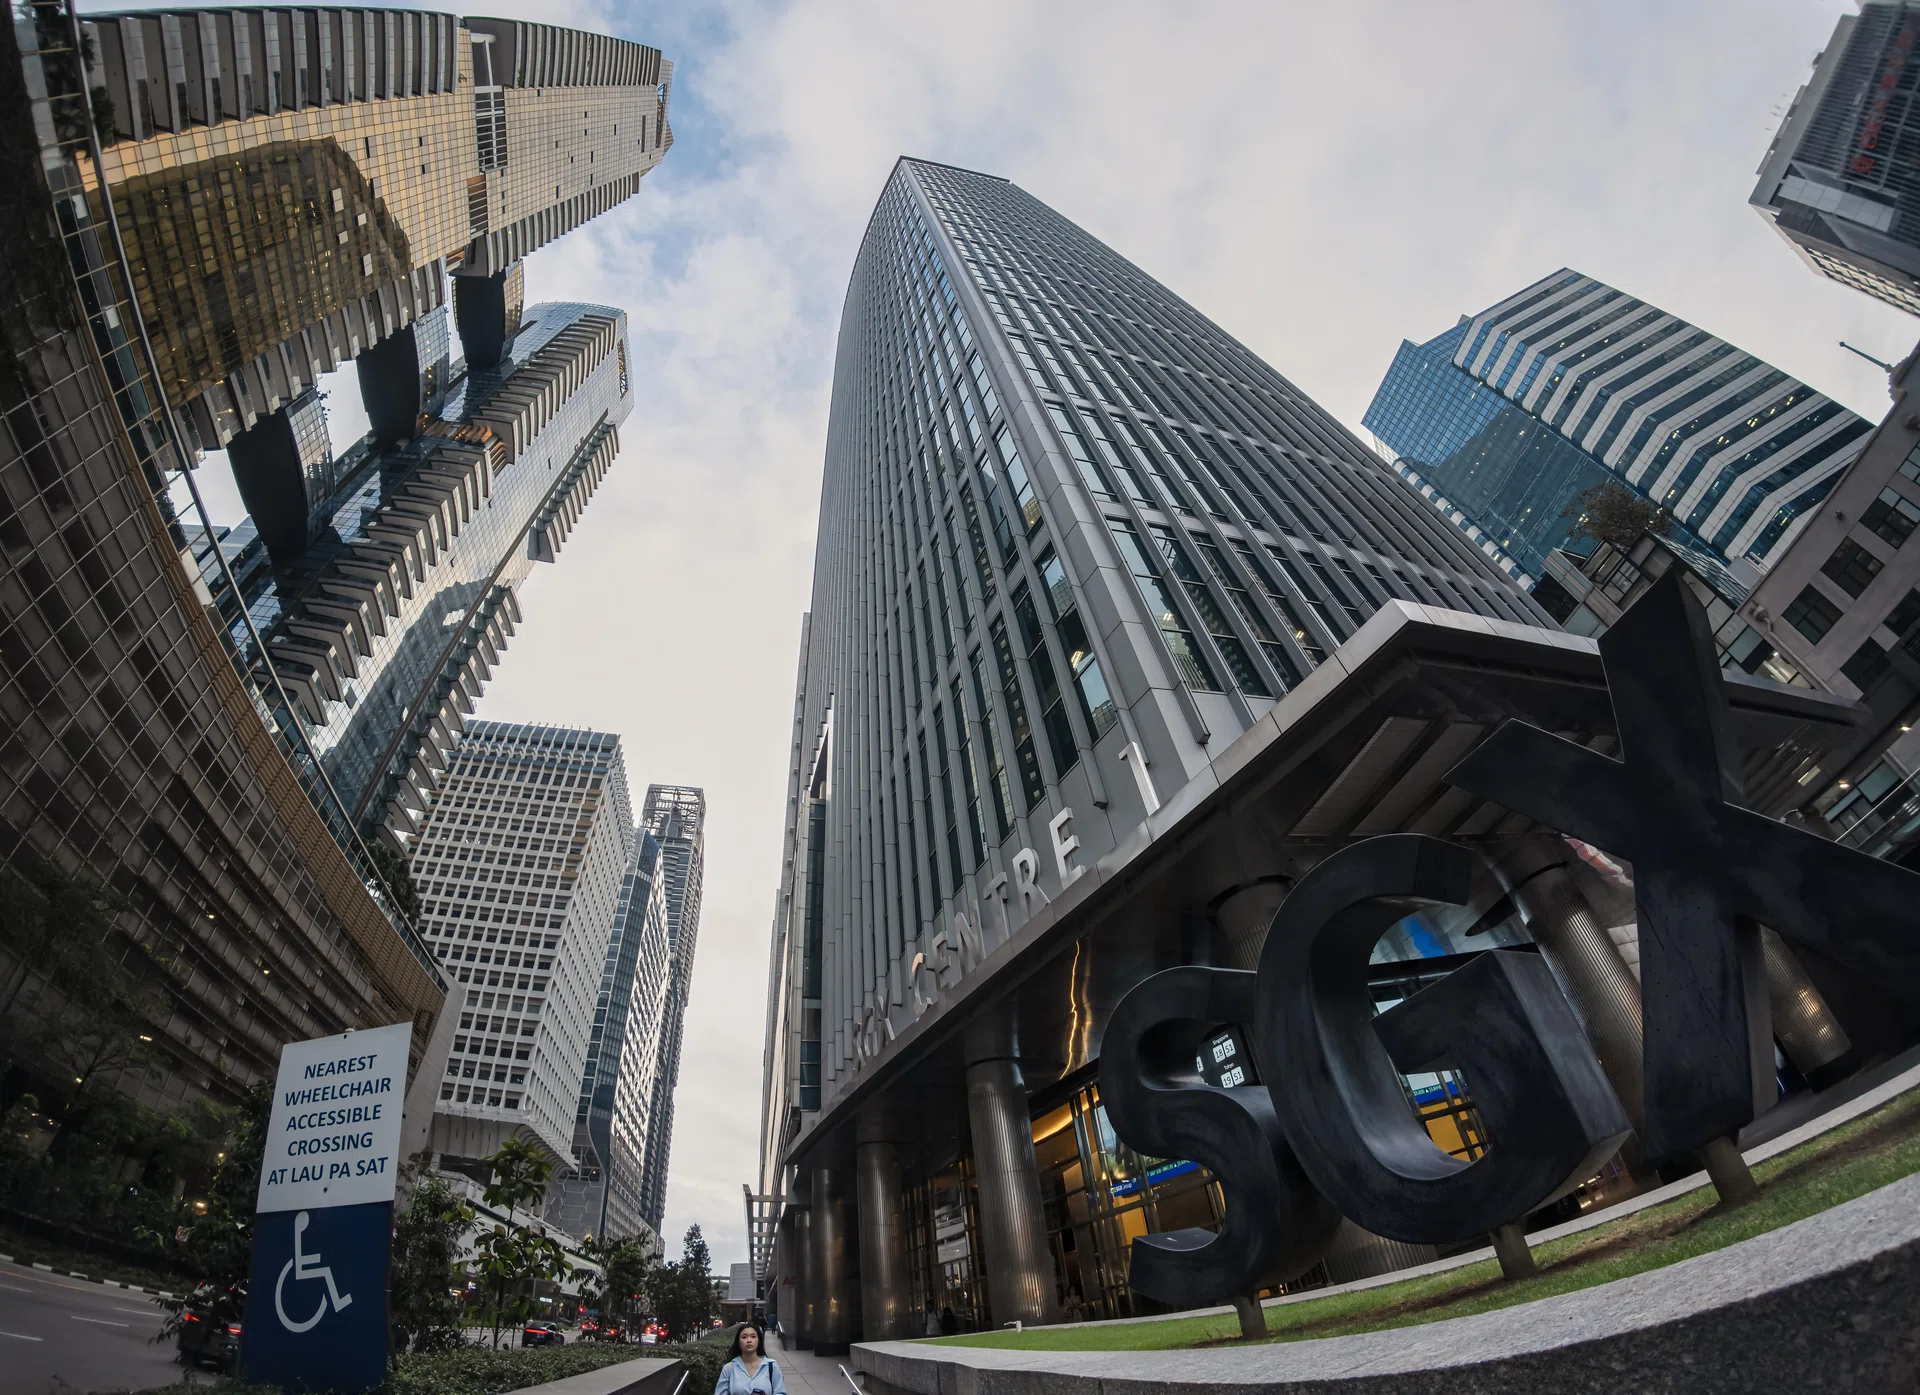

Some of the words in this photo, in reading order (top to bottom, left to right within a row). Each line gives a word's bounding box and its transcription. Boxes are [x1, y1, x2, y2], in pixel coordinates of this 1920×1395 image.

[911, 807, 1087, 1023] CENTRE
[1118, 741, 1161, 816] 1
[1100, 560, 1920, 1304] SGX
[1215, 1049, 1224, 1059] 18
[1225, 1043, 1234, 1054] 51
[304, 1054, 378, 1080] NEAREST
[1223, 1076, 1232, 1086] 19
[1233, 1071, 1243, 1081] 51
[285, 1076, 392, 1107] WHEELCHAIR
[286, 1103, 382, 1132] ACCESSIBLE
[287, 1131, 374, 1157] CROSSING
[267, 1168, 288, 1186] AT
[291, 1164, 324, 1184] LAU
[329, 1161, 351, 1180] PA
[355, 1156, 389, 1177] SAT
